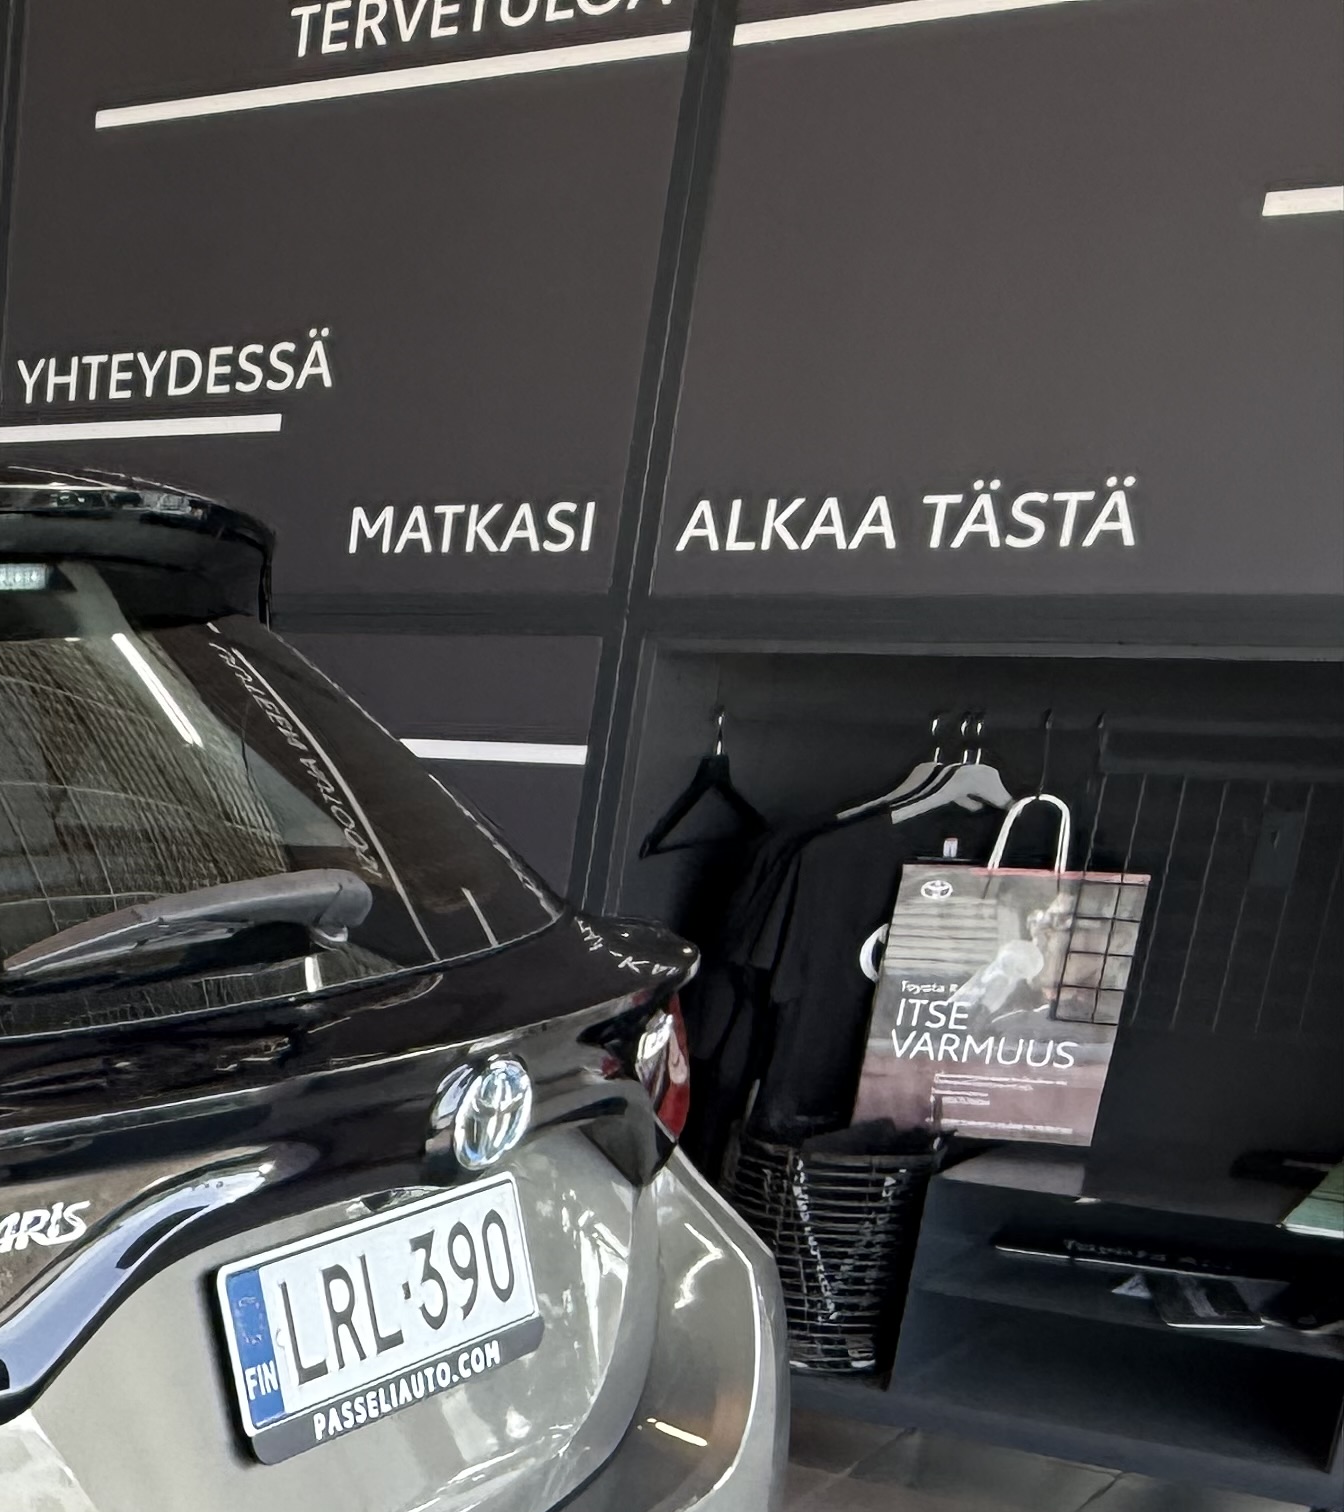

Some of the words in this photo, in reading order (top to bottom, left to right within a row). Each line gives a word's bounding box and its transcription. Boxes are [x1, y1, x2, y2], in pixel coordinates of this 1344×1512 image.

[290, 0, 672, 58] TERVETU
[17, 328, 334, 404] YHTEYDESSÄ
[347, 501, 596, 555] MATKASI
[675, 496, 897, 552] ALKAA
[922, 476, 1137, 549] TÄSTÄ
[896, 998, 970, 1030] ITSE
[891, 1028, 1080, 1069] VARMUUS
[279, 1208, 515, 1386] LRL-390
[244, 1360, 279, 1401] FIN
[313, 1340, 501, 1441] PASSELIAUTO.COM
